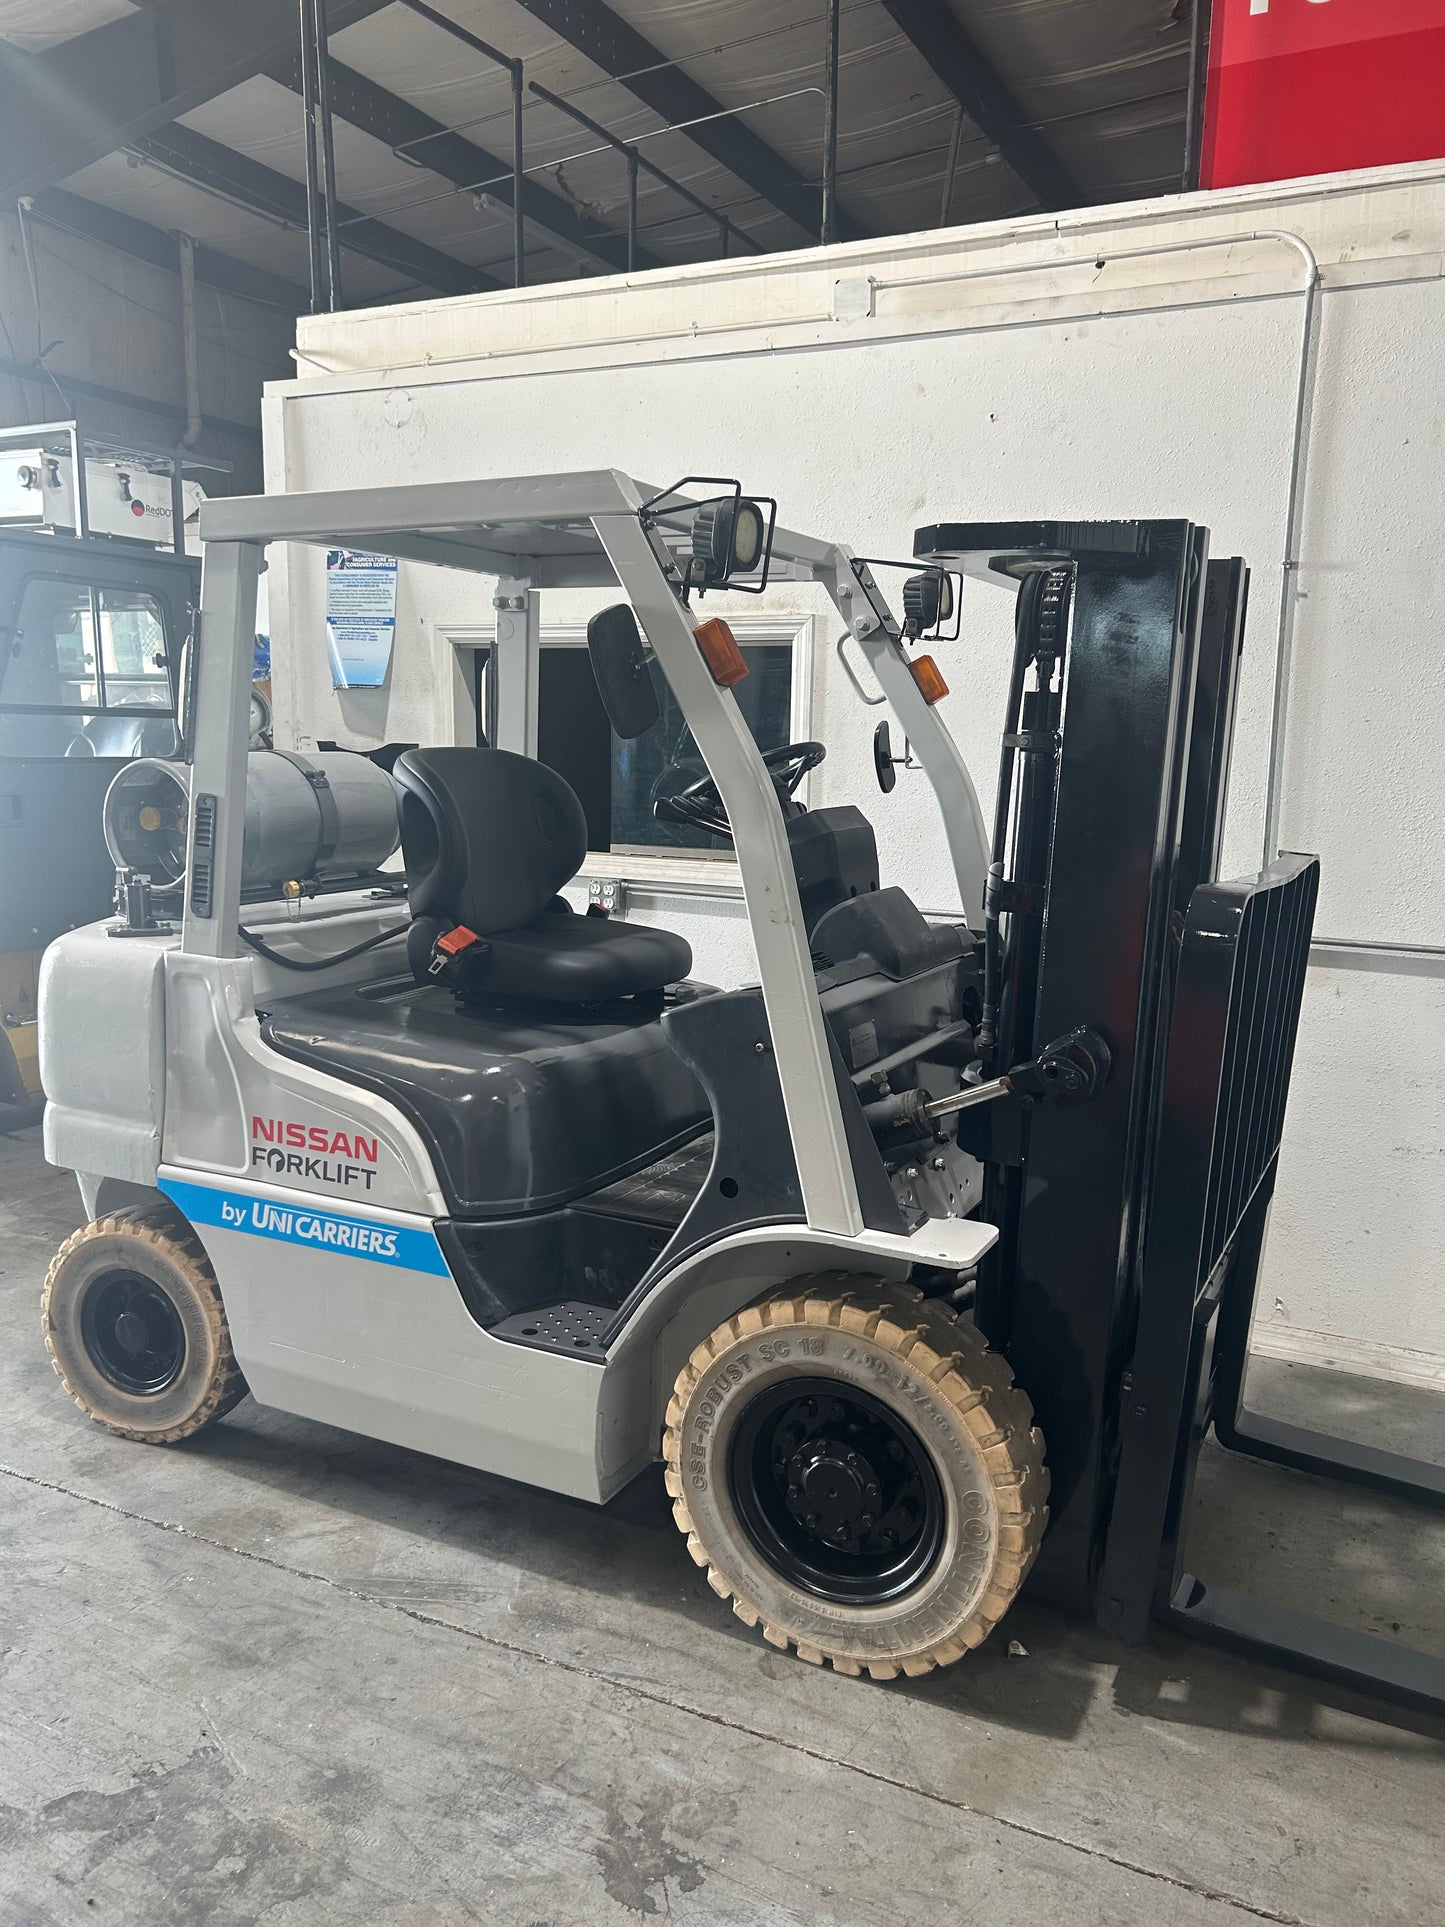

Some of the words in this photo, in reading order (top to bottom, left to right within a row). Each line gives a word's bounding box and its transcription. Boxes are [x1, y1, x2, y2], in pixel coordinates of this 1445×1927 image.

[146, 505, 173, 517] RedDO
[252, 1116, 378, 1163] NISSAN
[252, 1147, 377, 1190] FORKLIFT
[221, 1201, 247, 1226] by
[690, 1352, 752, 1491] CSE-ROBUST
[758, 1338, 790, 1362] SC
[798, 1337, 825, 1356] 18
[832, 1490, 990, 1650] CONTINENTAL
